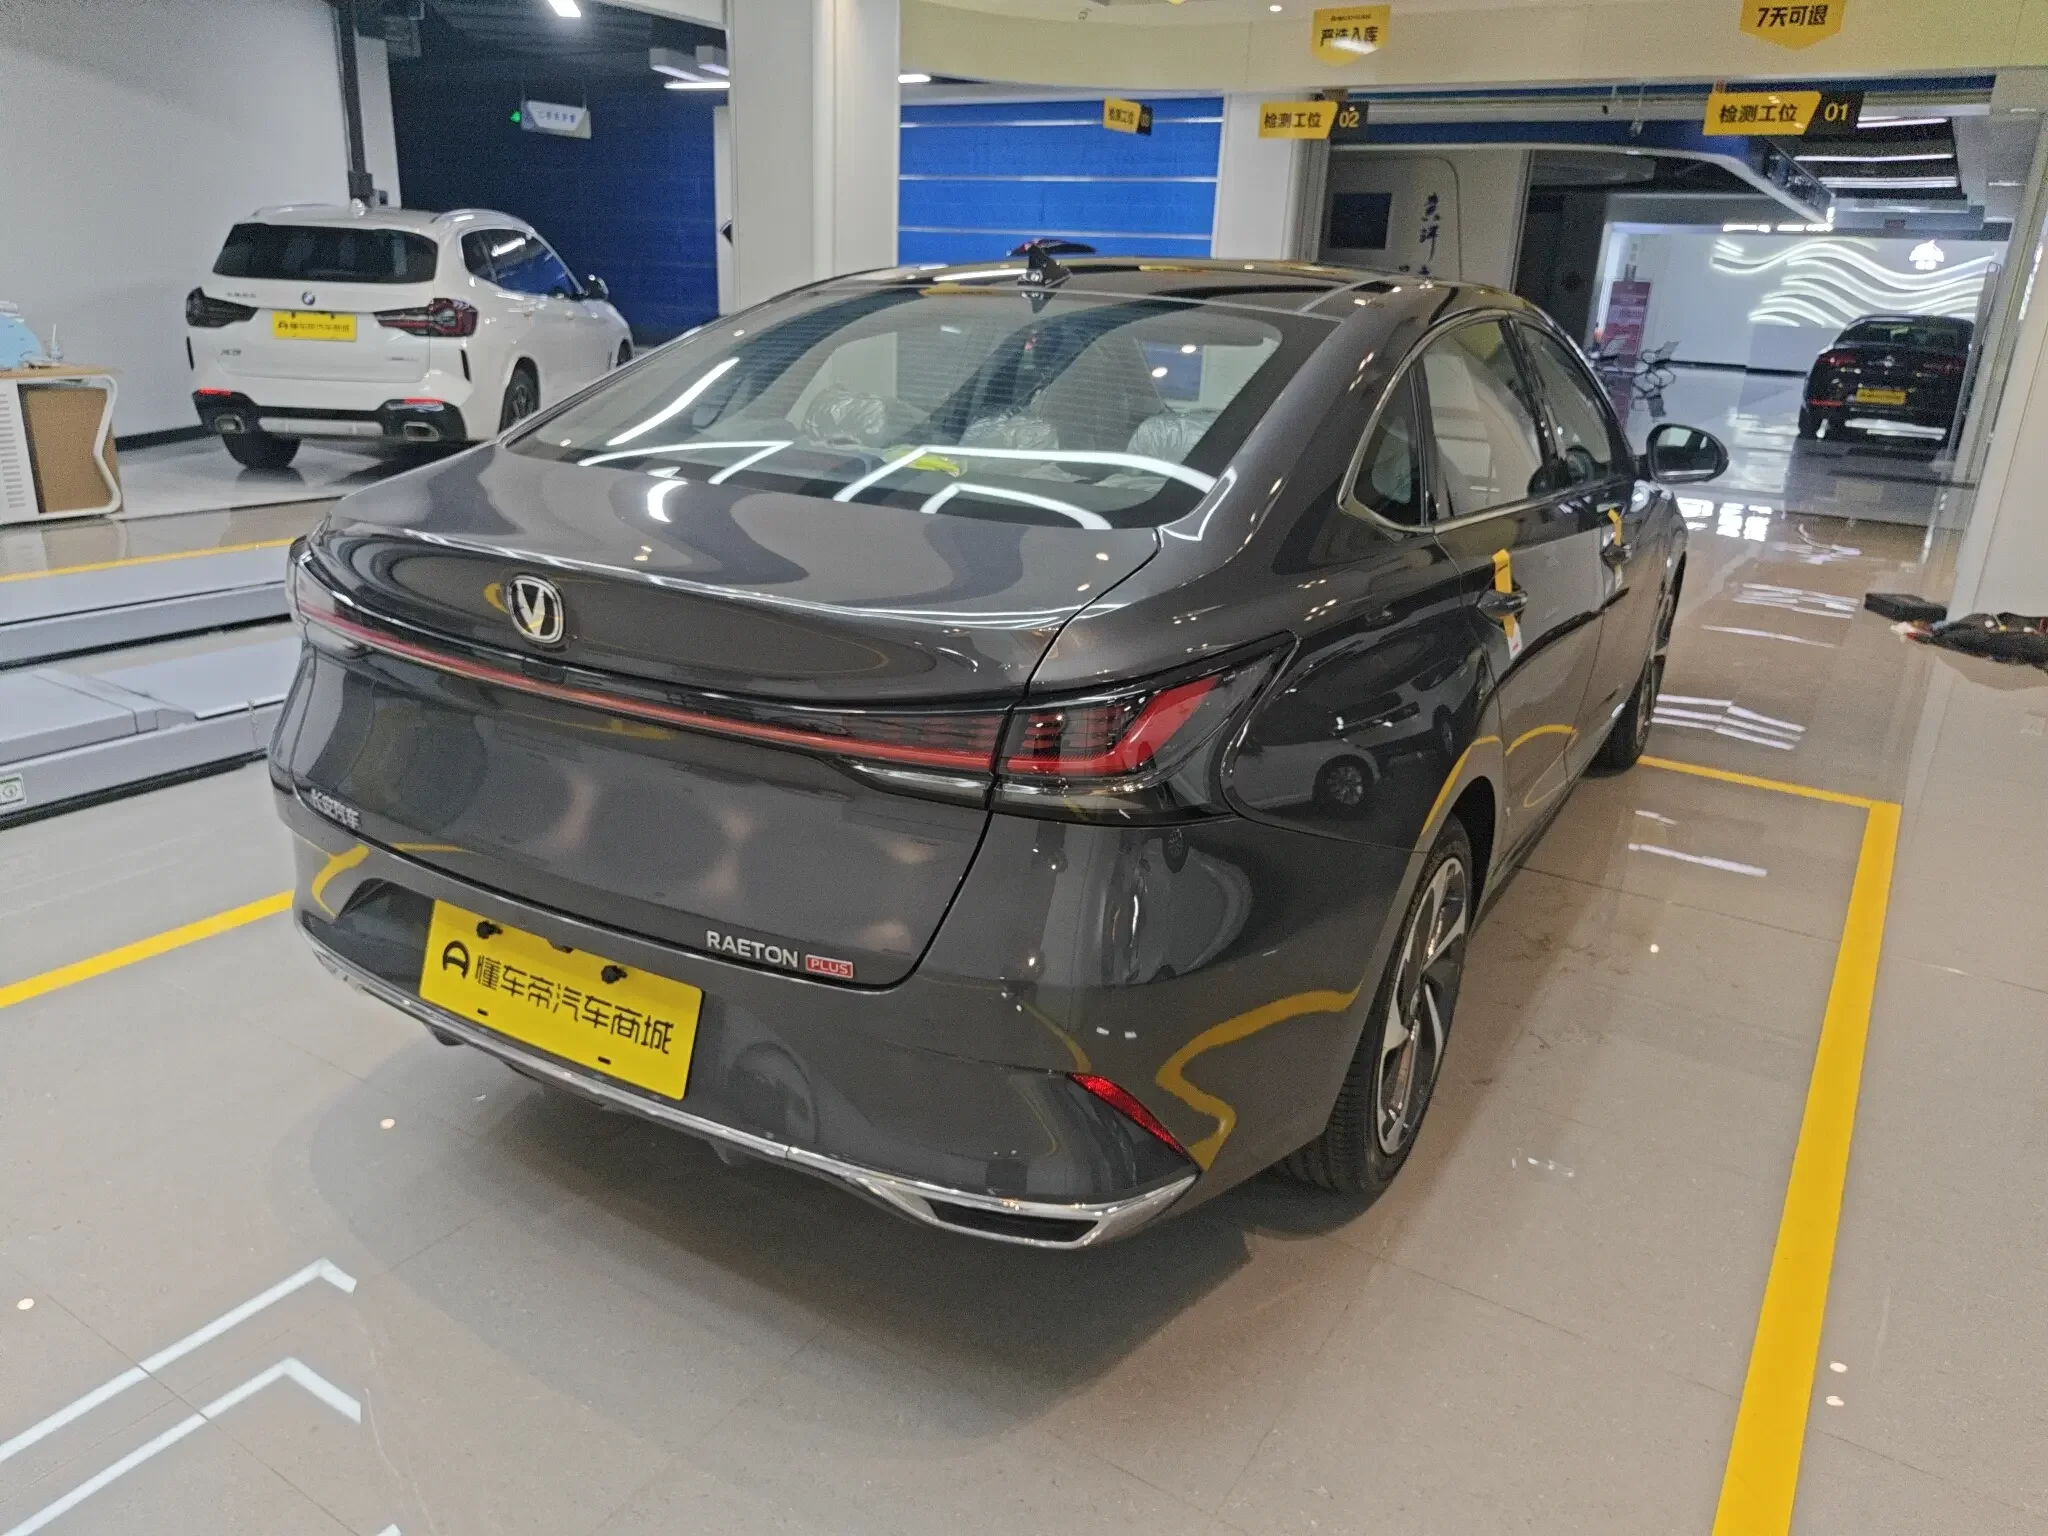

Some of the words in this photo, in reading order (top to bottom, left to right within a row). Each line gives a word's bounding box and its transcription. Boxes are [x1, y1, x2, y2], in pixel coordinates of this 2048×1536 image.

[1756, 5, 1828, 27] 7天可退
[1264, 112, 1322, 129] 检测工位
[1339, 111, 1360, 127] 02
[1719, 104, 1799, 123] 检测工位
[1824, 103, 1849, 121] 01
[706, 930, 798, 968] RAETON
[810, 958, 849, 974] PLUS
[476, 954, 674, 1055] 懂车帝汽车商城
